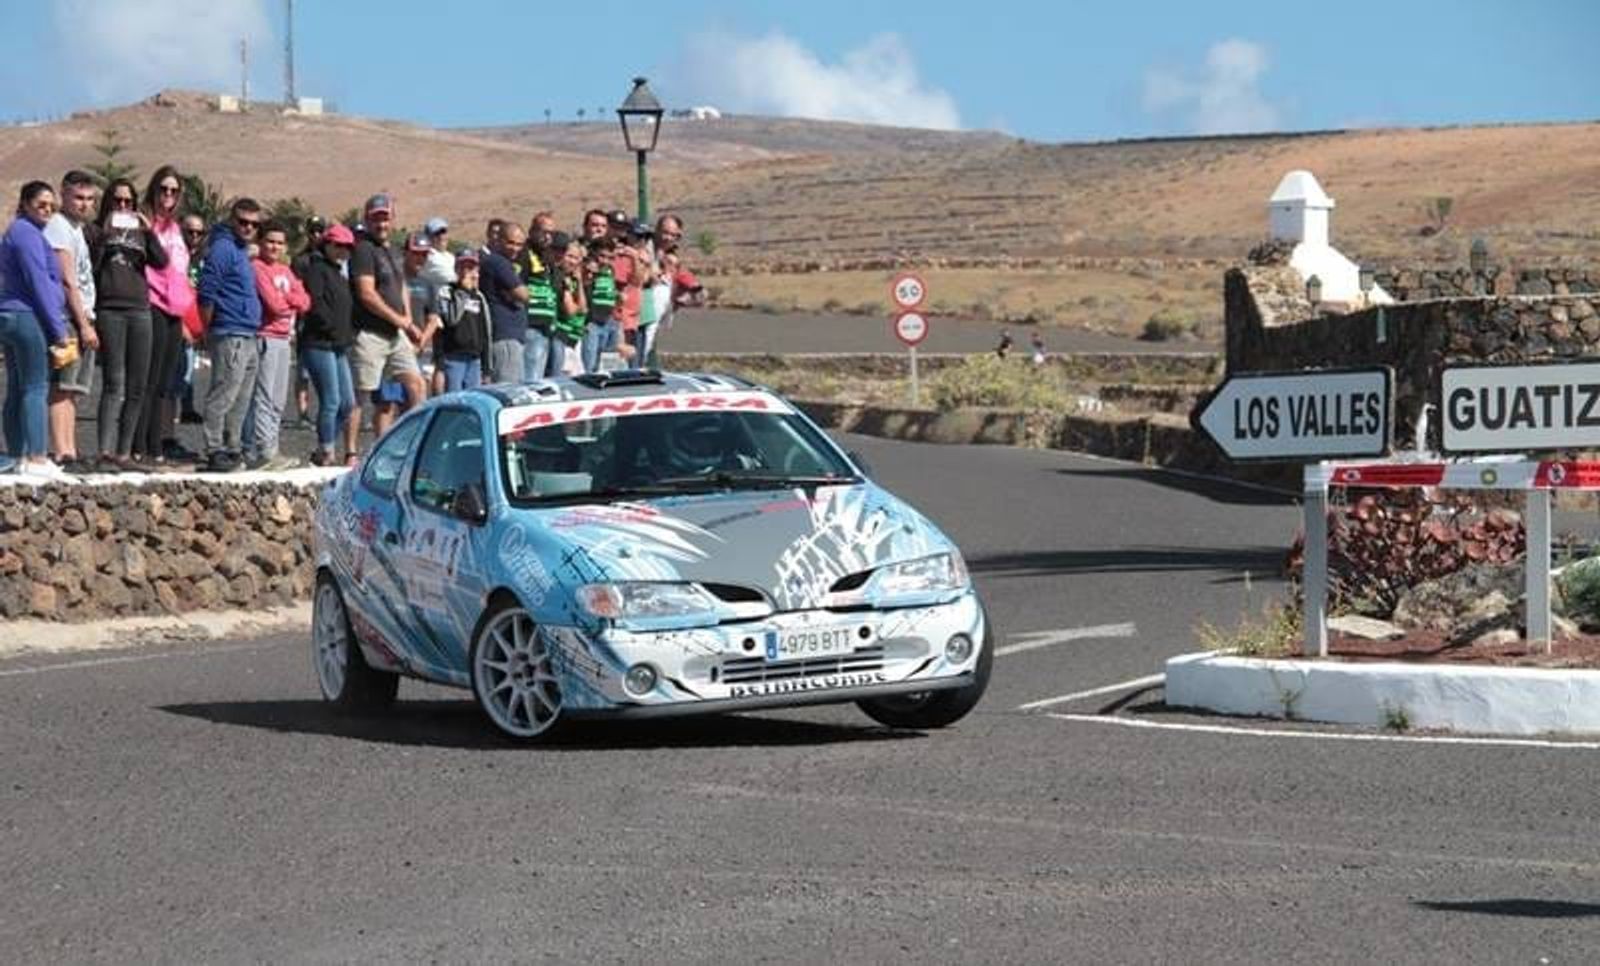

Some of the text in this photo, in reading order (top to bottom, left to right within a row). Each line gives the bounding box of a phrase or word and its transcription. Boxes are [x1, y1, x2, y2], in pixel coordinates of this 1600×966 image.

[512, 396, 769, 430] AINARA
[1234, 391, 1380, 440] LOS VALLES
[1448, 383, 1600, 431] GUATIZ
[778, 629, 850, 654] 4979 BTT
